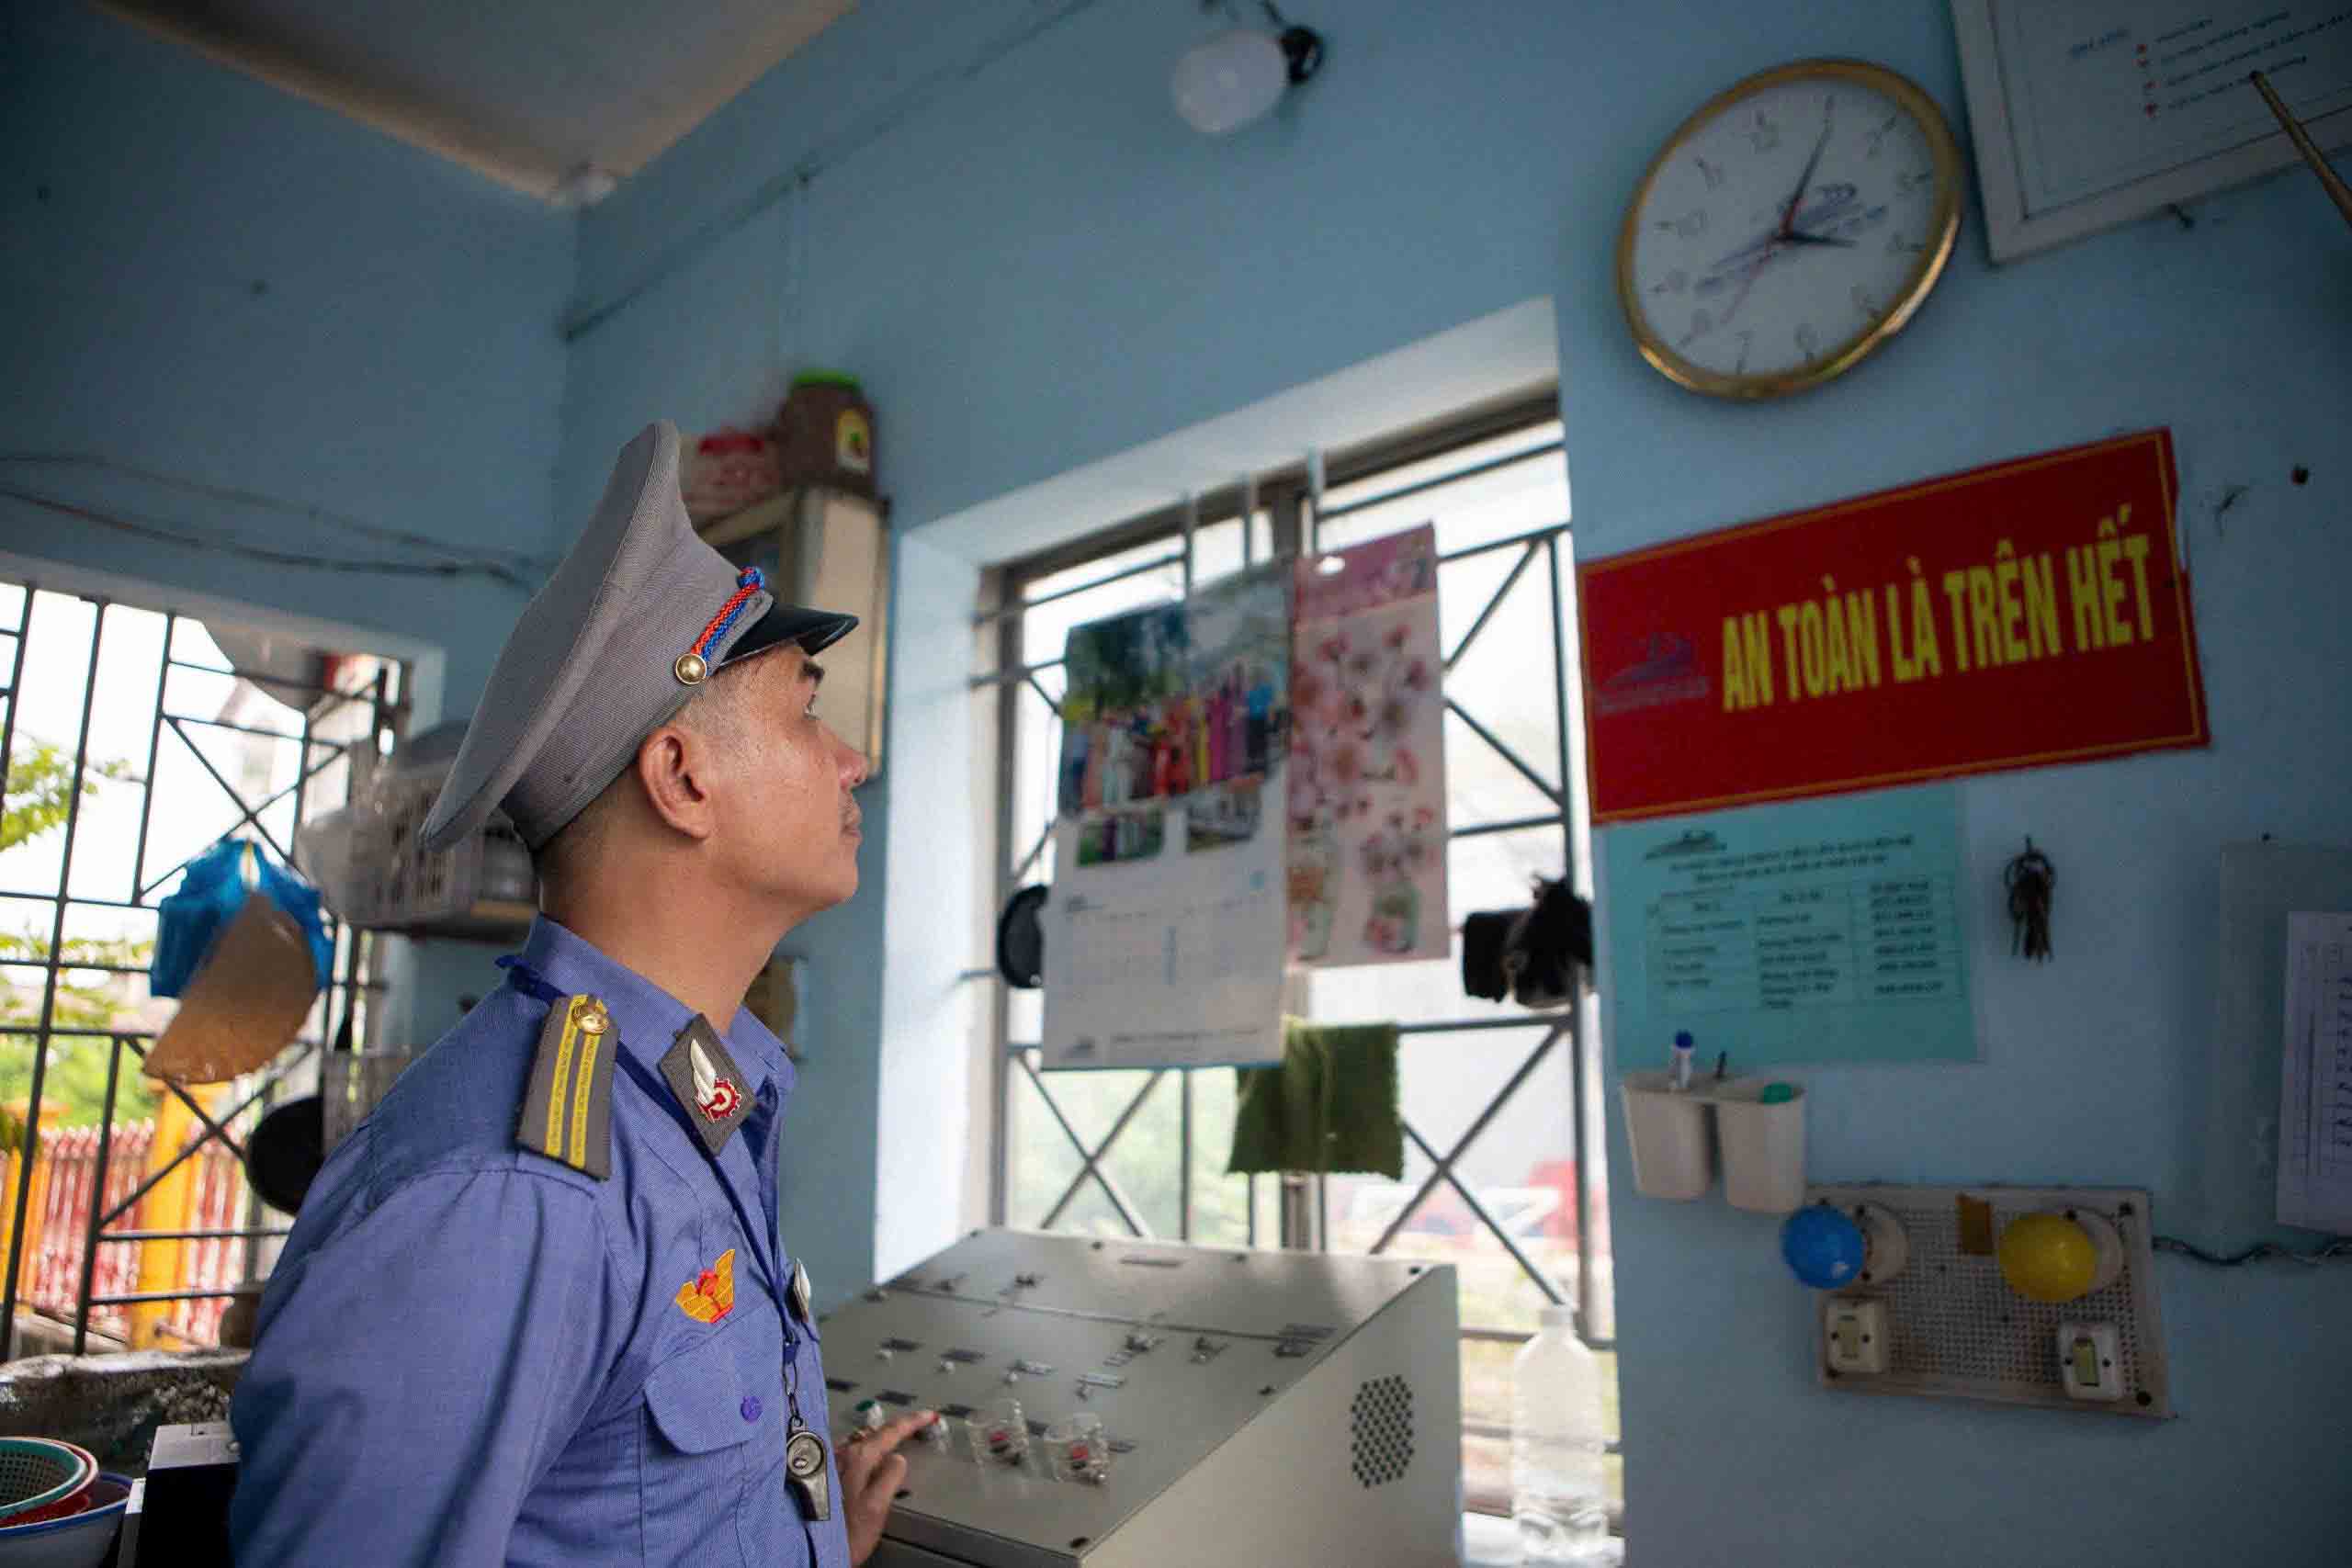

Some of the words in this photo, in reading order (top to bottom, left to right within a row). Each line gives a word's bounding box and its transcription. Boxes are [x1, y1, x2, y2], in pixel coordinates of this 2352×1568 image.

[1724, 611, 1773, 712] AN
[1778, 573, 1881, 702] TOÀN
[1885, 556, 1941, 682] LÀ
[1943, 538, 2061, 671] TRÊN
[2067, 503, 2153, 653] HẾT
